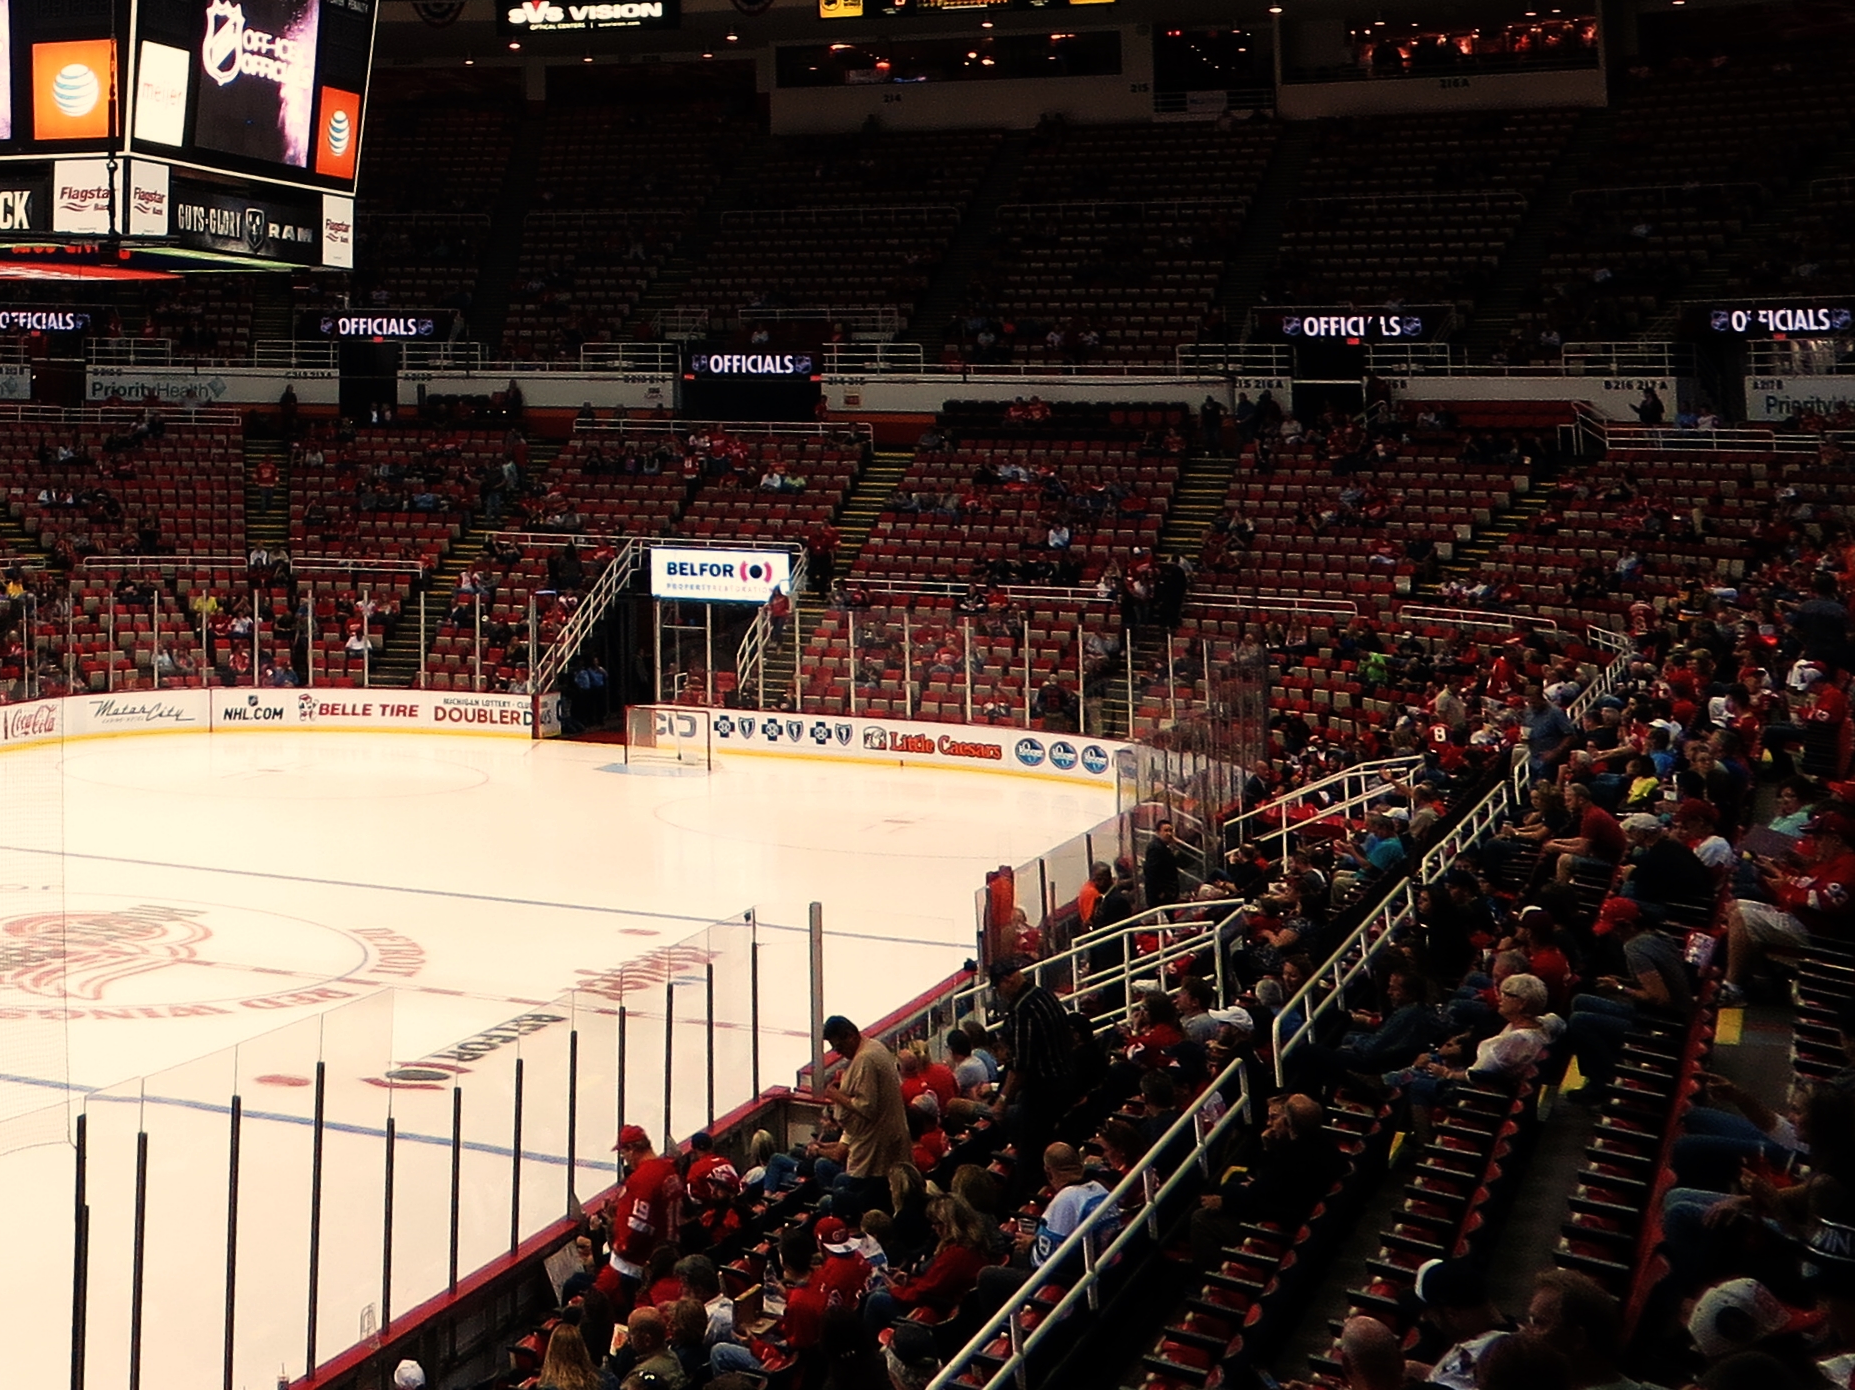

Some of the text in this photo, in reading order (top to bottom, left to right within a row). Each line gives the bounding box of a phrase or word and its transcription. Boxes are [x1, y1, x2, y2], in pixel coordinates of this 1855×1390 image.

[569, 2, 662, 20] VISION
[134, 187, 165, 203] Flagstar
[268, 223, 313, 242] RAM
[338, 317, 417, 337] OFFICIALS
[709, 354, 794, 375] OFFICIALS
[667, 562, 734, 578] BELFOR
[223, 707, 284, 721] NHL.COM
[318, 703, 420, 718] BELLE TIRE
[889, 731, 1002, 760] Little Caesars
